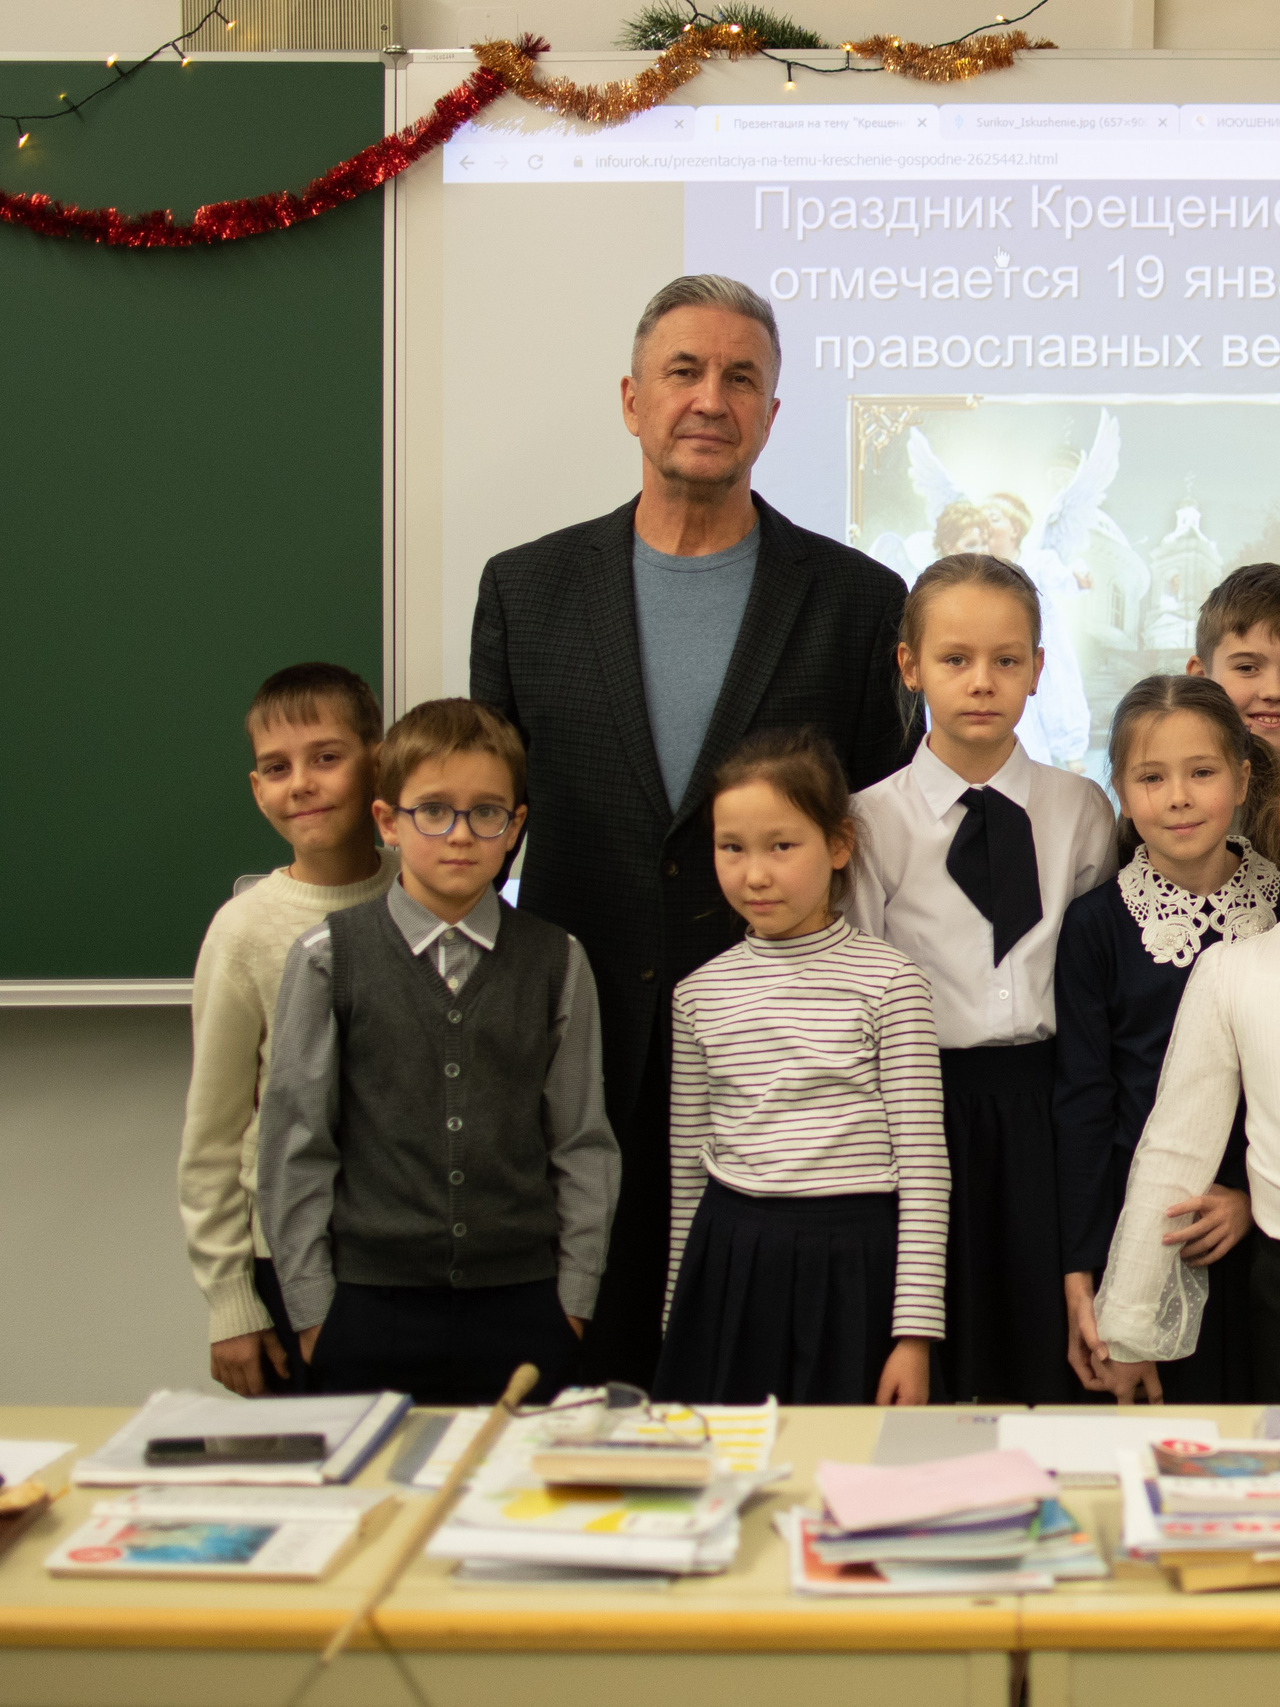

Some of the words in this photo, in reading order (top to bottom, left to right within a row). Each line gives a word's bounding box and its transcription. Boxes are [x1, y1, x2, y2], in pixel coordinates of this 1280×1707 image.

[734, 117, 804, 131] Презентация
[807, 119, 820, 129] на
[824, 119, 850, 131] тему
[976, 116, 1096, 130] Surikov_Iskushenie.jpg
[595, 152, 1059, 171] infourok.ru/prezentaciya-na-temu-kreschenie-gospodne-2625442.html
[755, 186, 1011, 241] Праздник
[769, 264, 1081, 302] отмечается
[1106, 255, 1166, 300] 19
[815, 333, 1202, 379] православных
